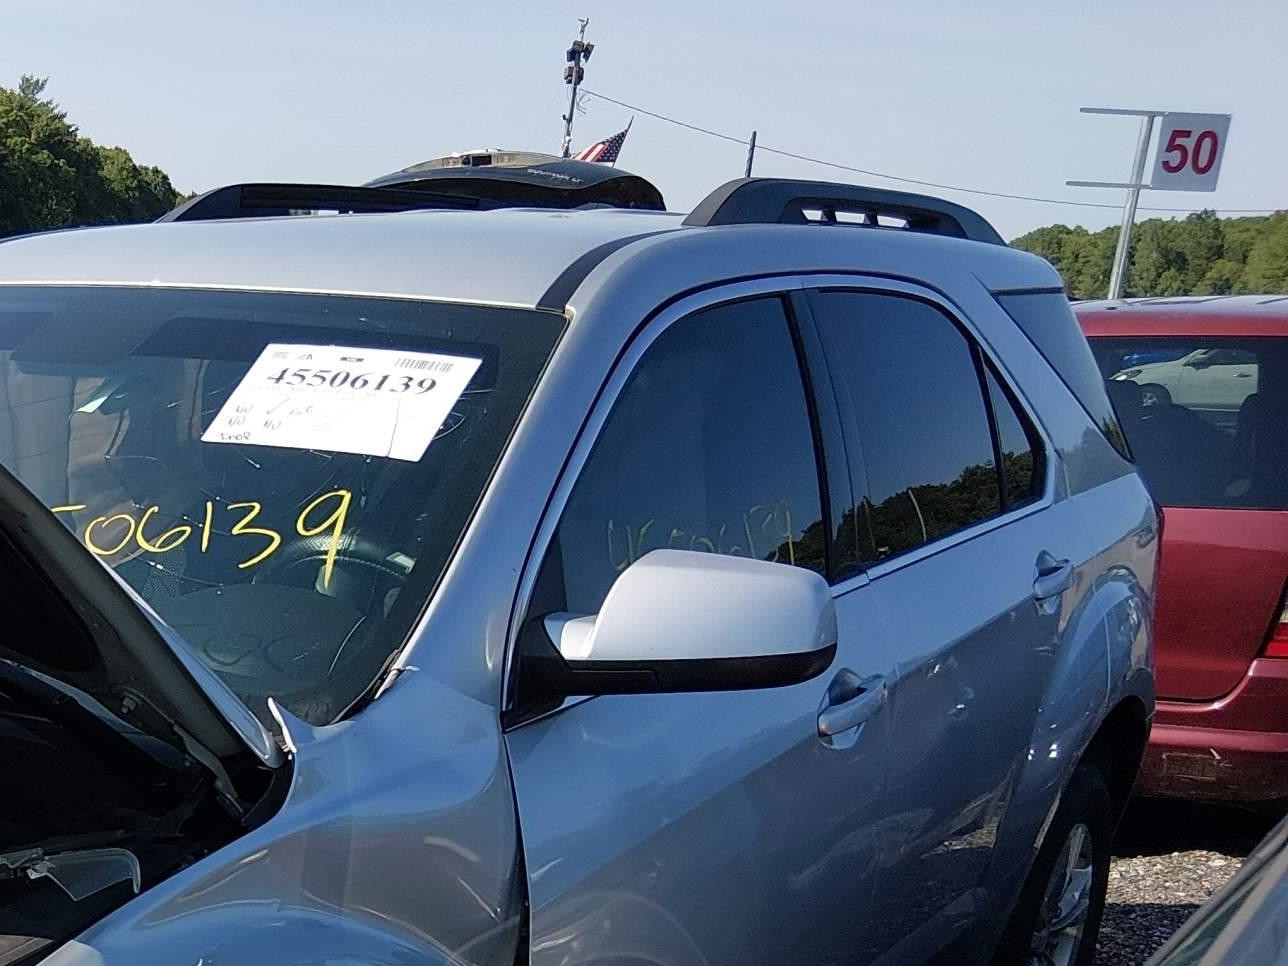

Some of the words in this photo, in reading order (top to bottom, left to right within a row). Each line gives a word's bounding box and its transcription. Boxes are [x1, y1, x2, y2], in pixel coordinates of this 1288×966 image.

[1161, 130, 1219, 175] 50
[266, 366, 438, 396] 45506139
[50, 489, 352, 590] 06139
